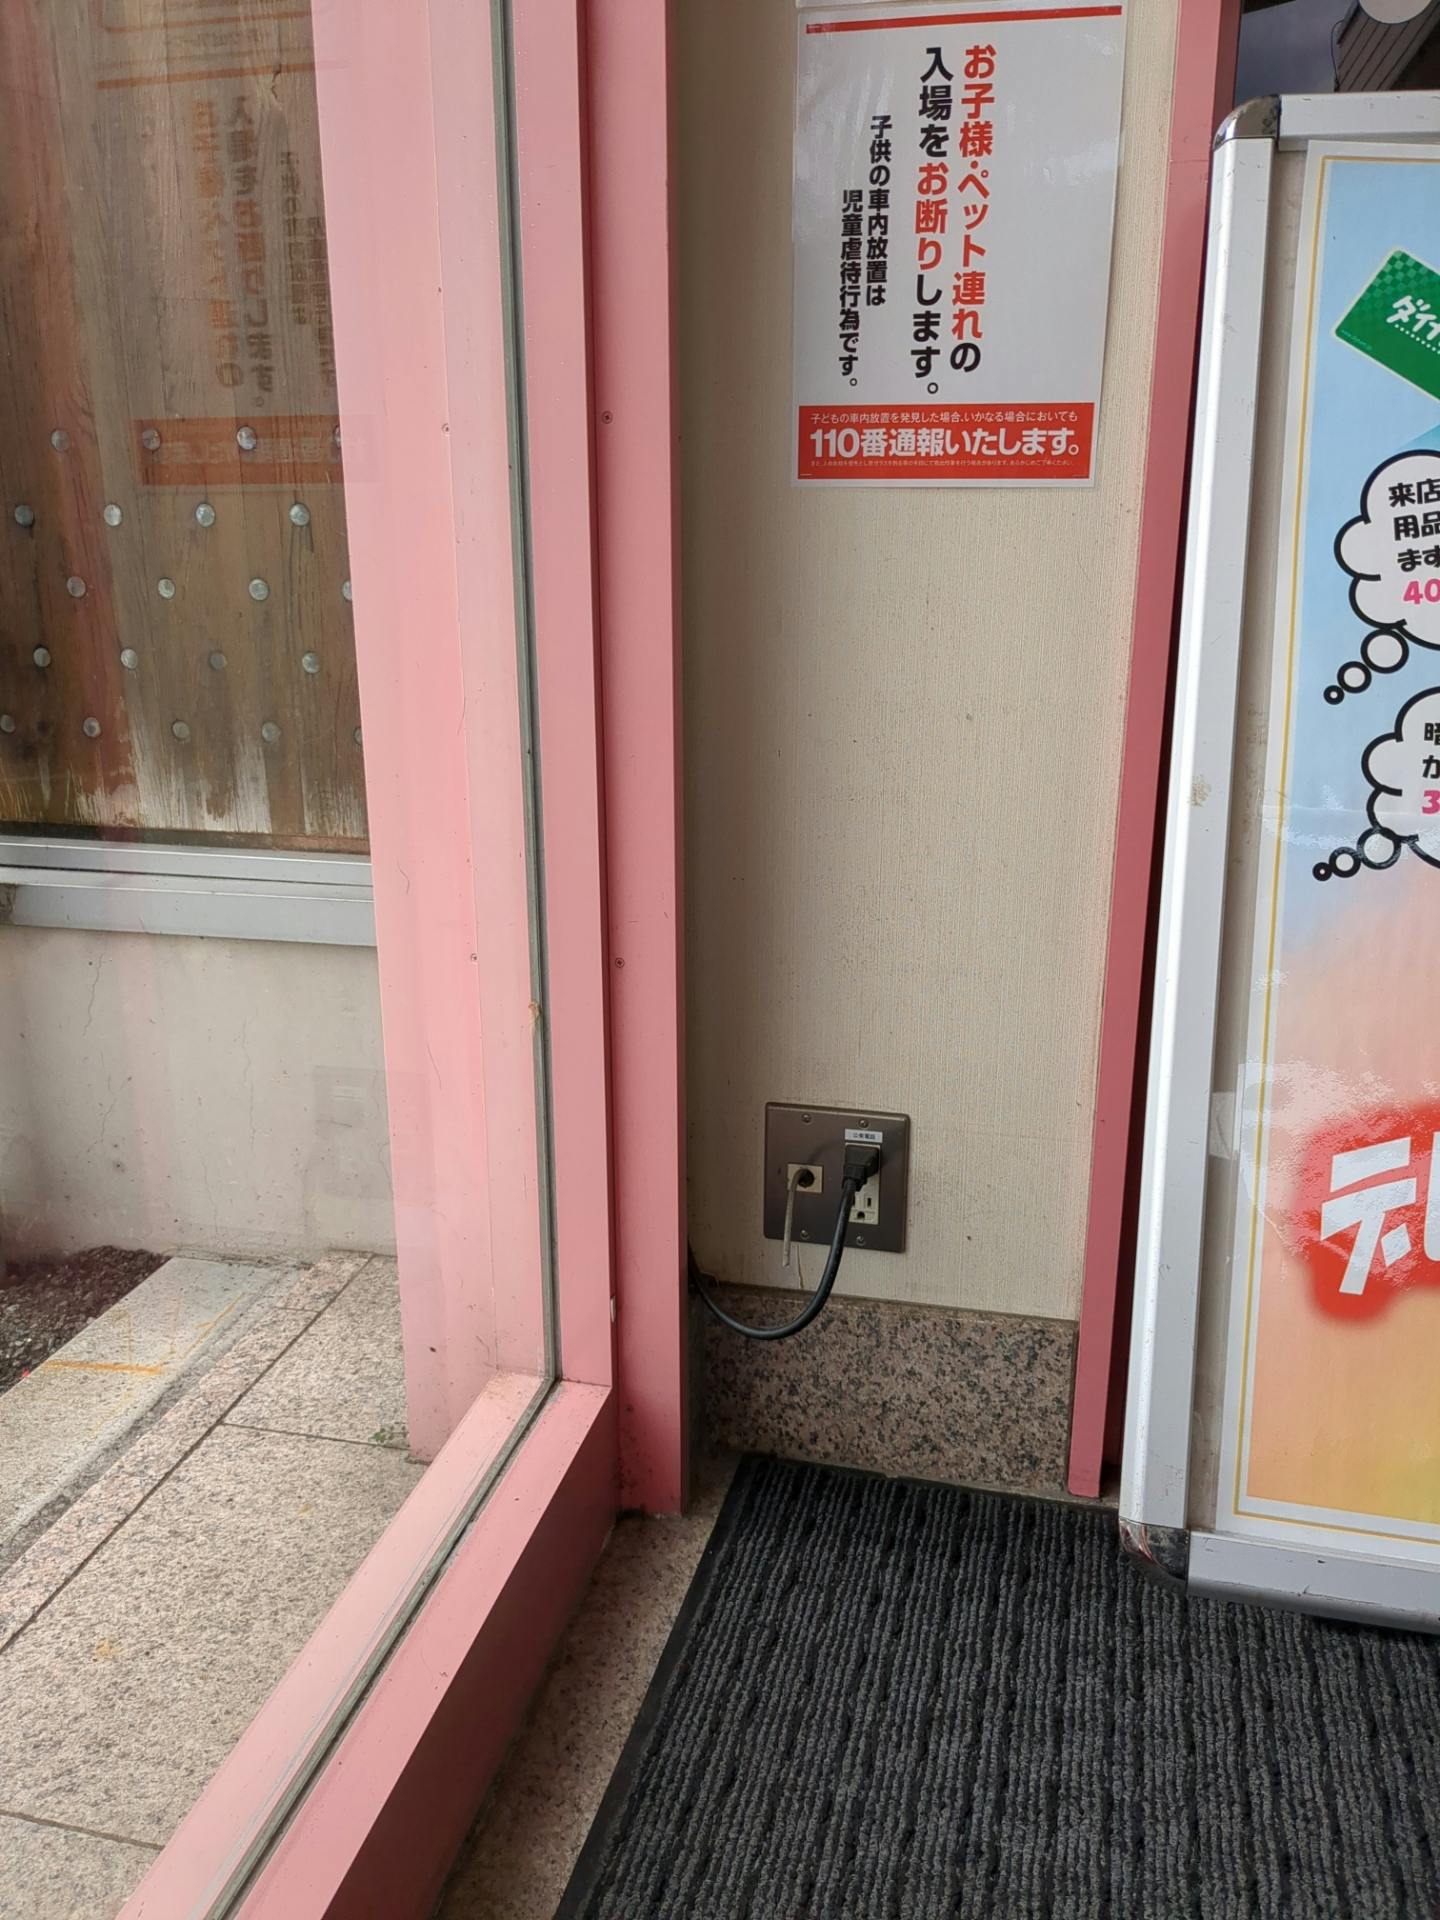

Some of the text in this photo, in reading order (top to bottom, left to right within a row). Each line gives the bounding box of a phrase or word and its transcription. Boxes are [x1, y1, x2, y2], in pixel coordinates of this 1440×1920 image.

[838, 188, 863, 388] 児童虐待行為です。
[866, 114, 893, 307] 子供の車内放置は
[911, 46, 954, 395] 入場をお断りします。
[950, 44, 997, 373] お子様・ペット連れの
[810, 426, 1080, 458] 110番通報いたします。
